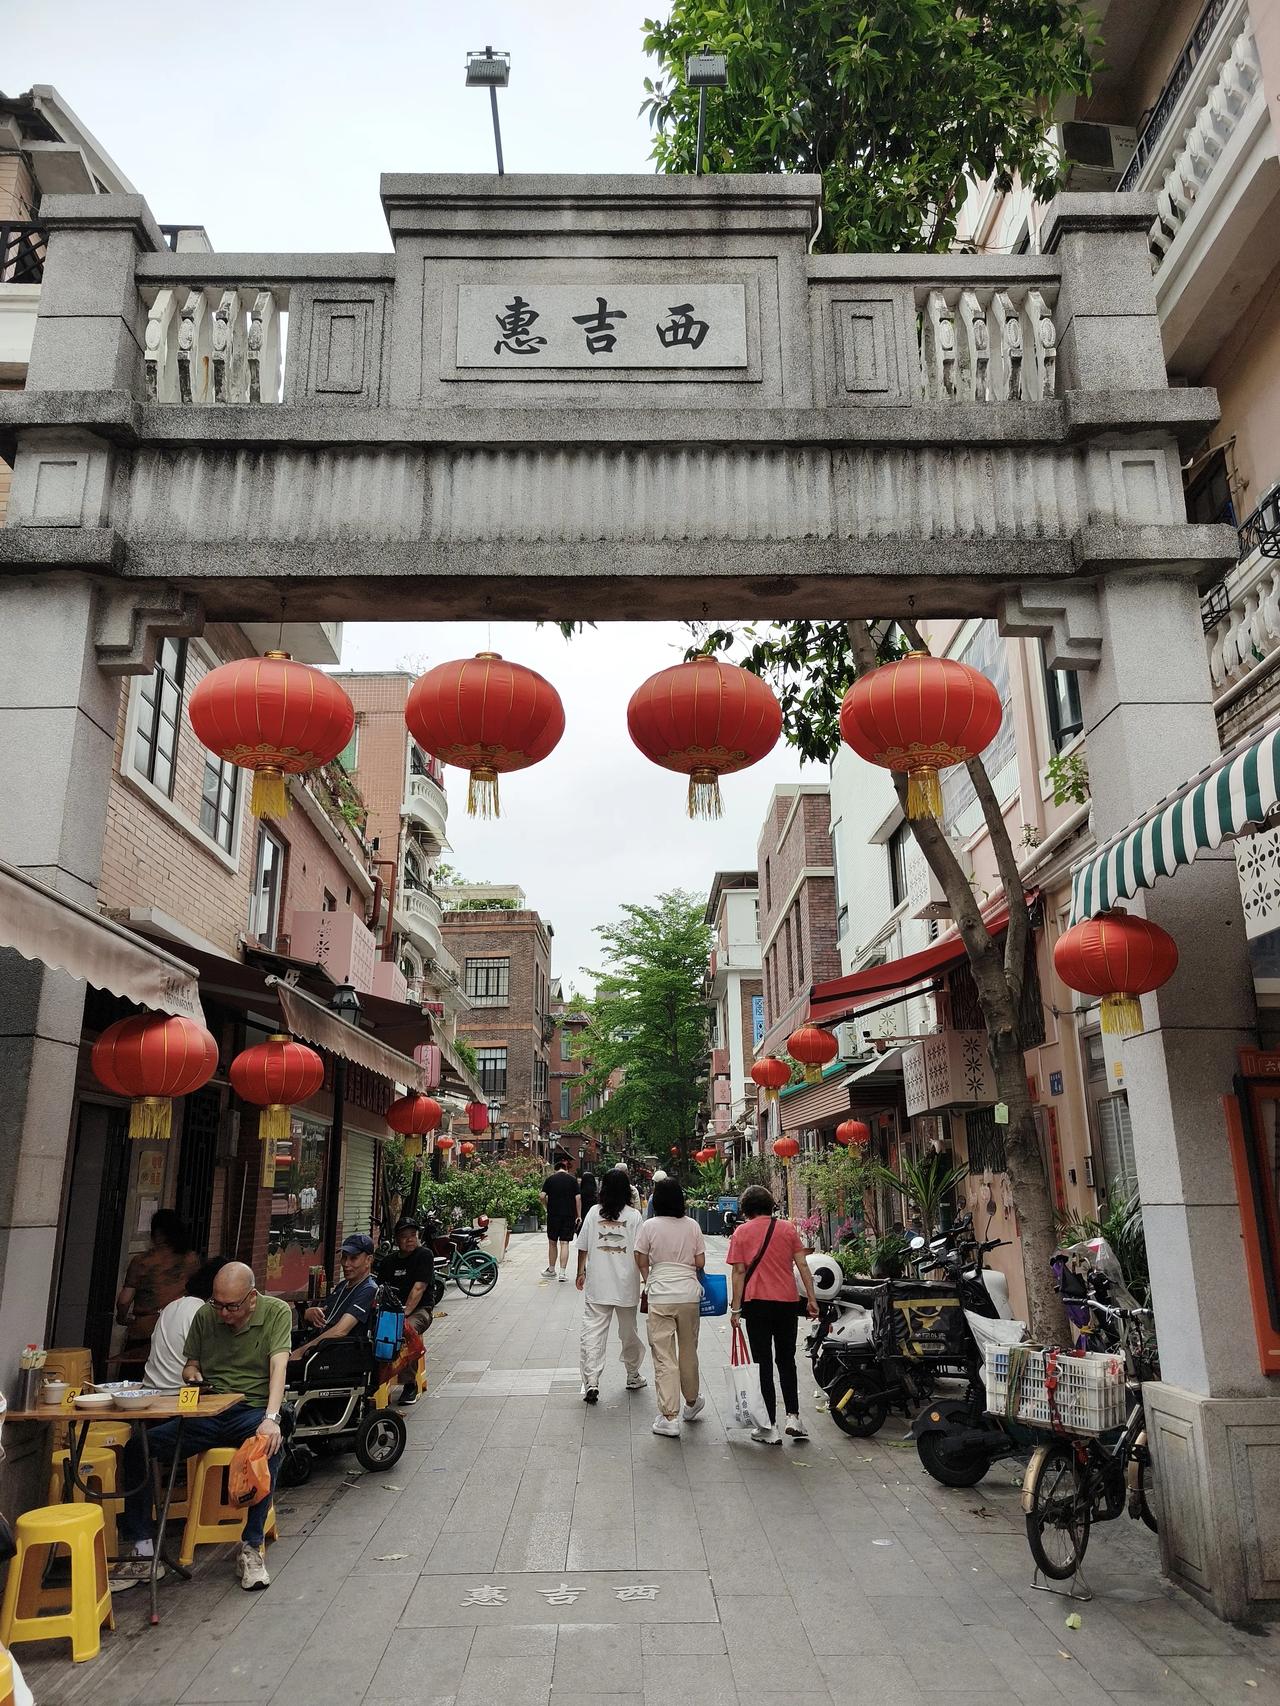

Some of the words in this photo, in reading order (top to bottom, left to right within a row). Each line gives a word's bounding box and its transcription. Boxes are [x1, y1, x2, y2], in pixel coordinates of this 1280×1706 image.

[494, 296, 710, 355] 惠吉西
[180, 1390, 197, 1404] 37
[459, 1583, 661, 1607] 惠吉西
